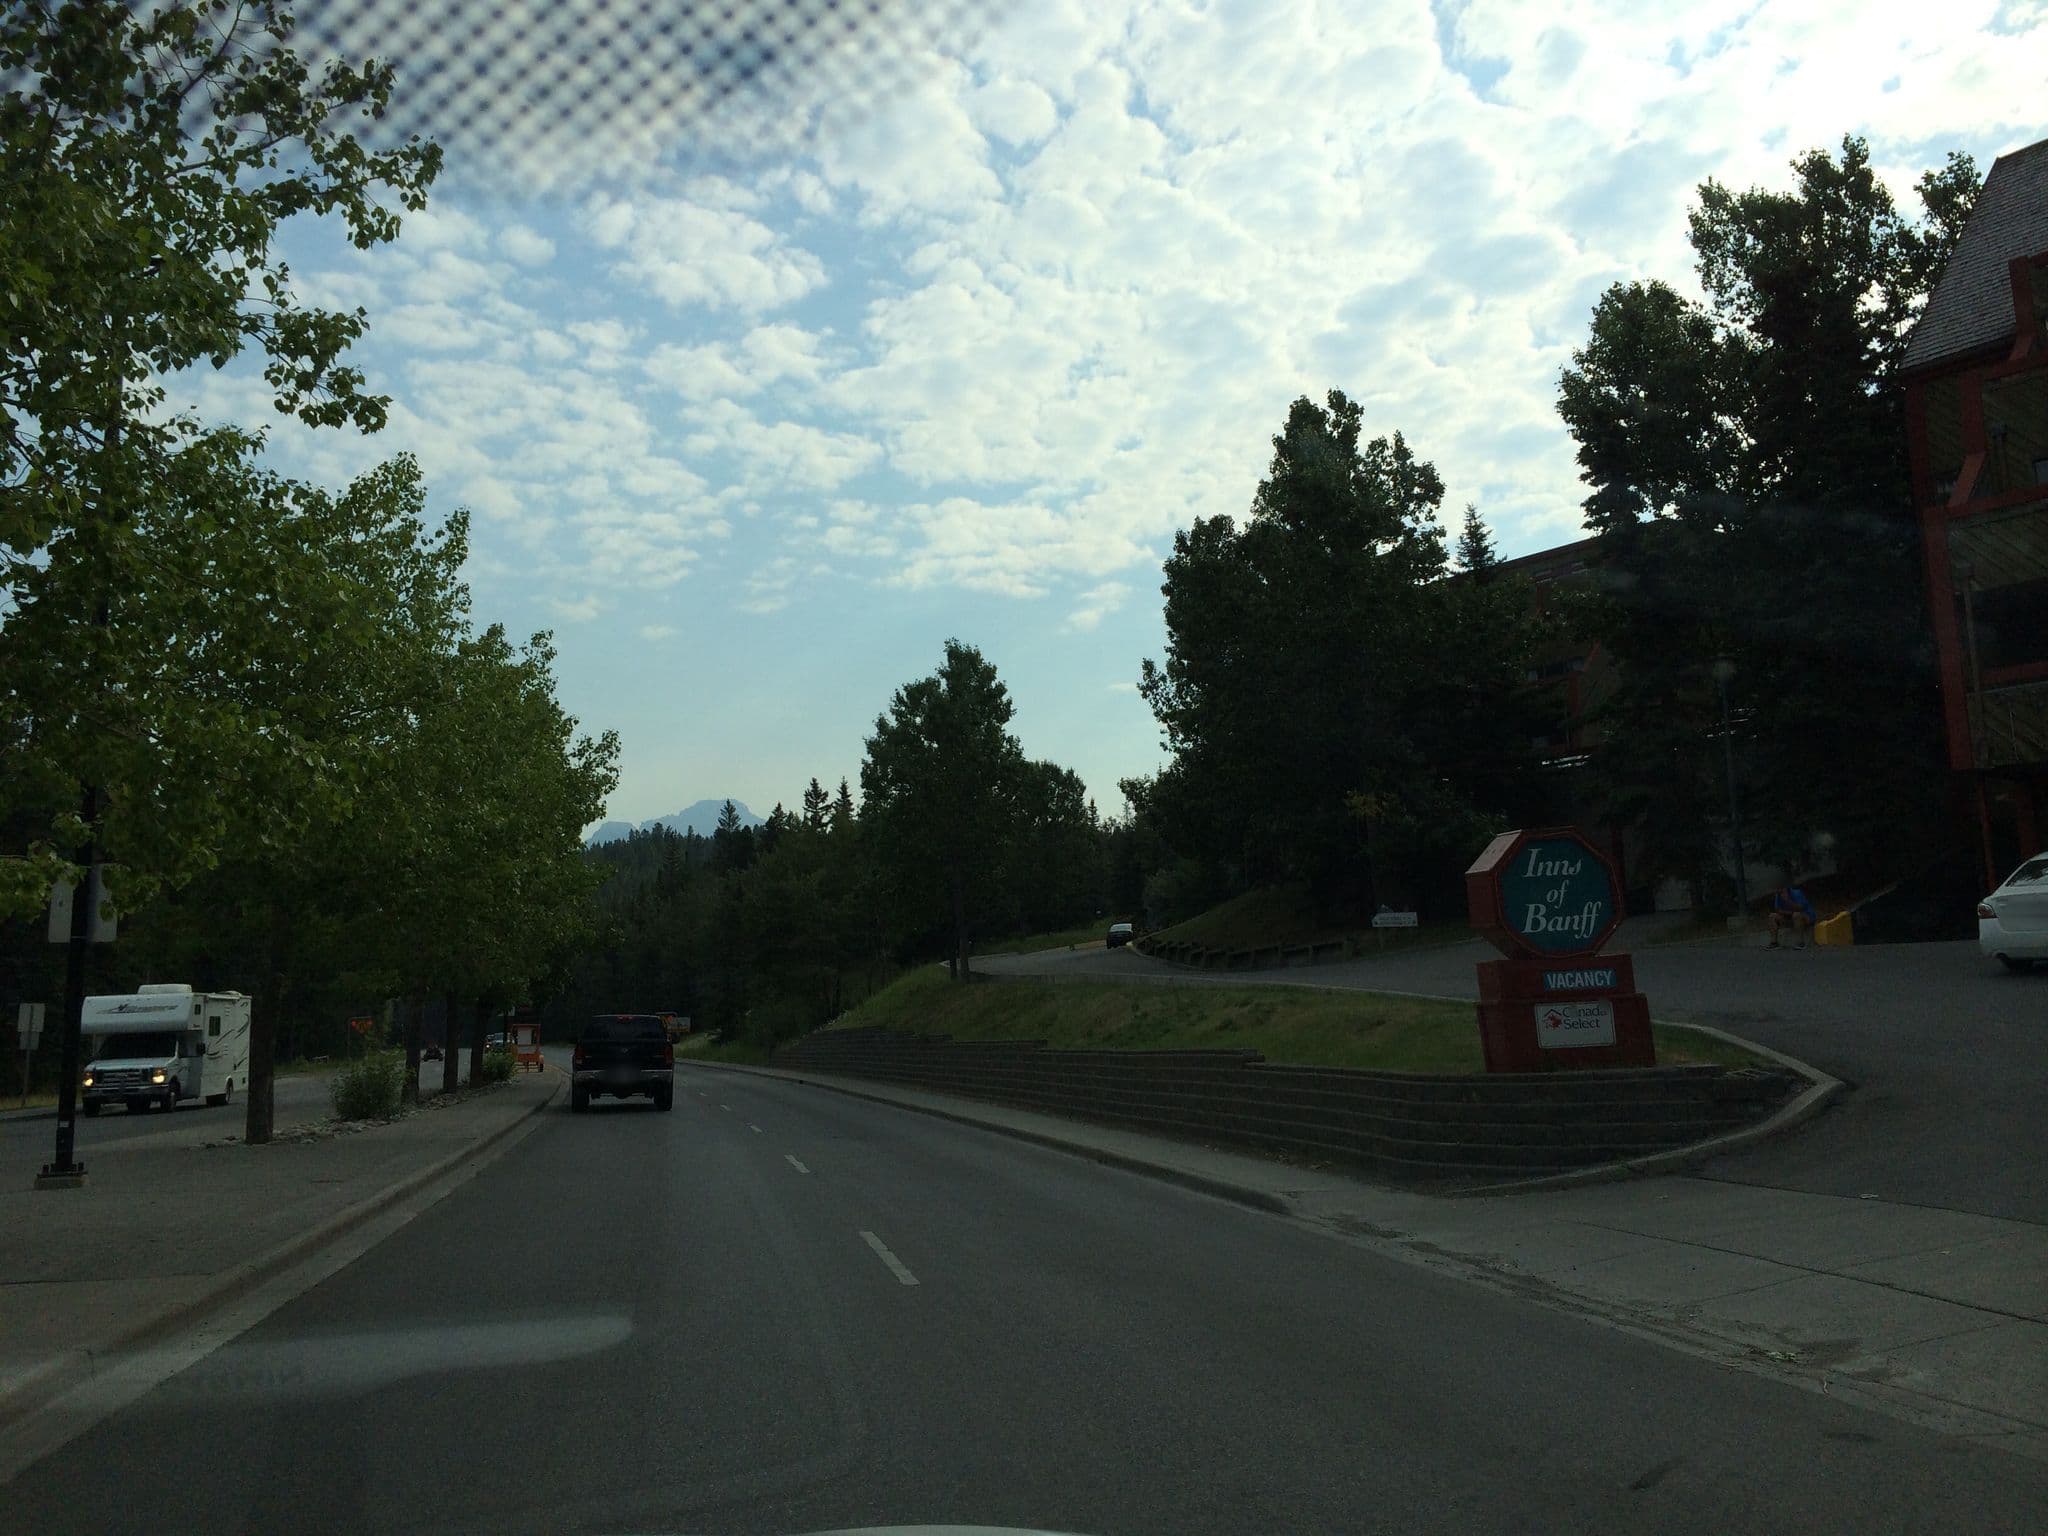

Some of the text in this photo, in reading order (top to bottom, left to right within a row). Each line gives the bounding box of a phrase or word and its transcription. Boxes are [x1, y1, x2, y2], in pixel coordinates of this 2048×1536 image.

[1523, 848, 1582, 878] Inns
[1546, 879, 1570, 909] of
[1520, 901, 1602, 939] Banff
[1547, 970, 1612, 989] VACANCY
[1562, 1006, 1608, 1018] Cnada
[1563, 1018, 1600, 1030] Select
